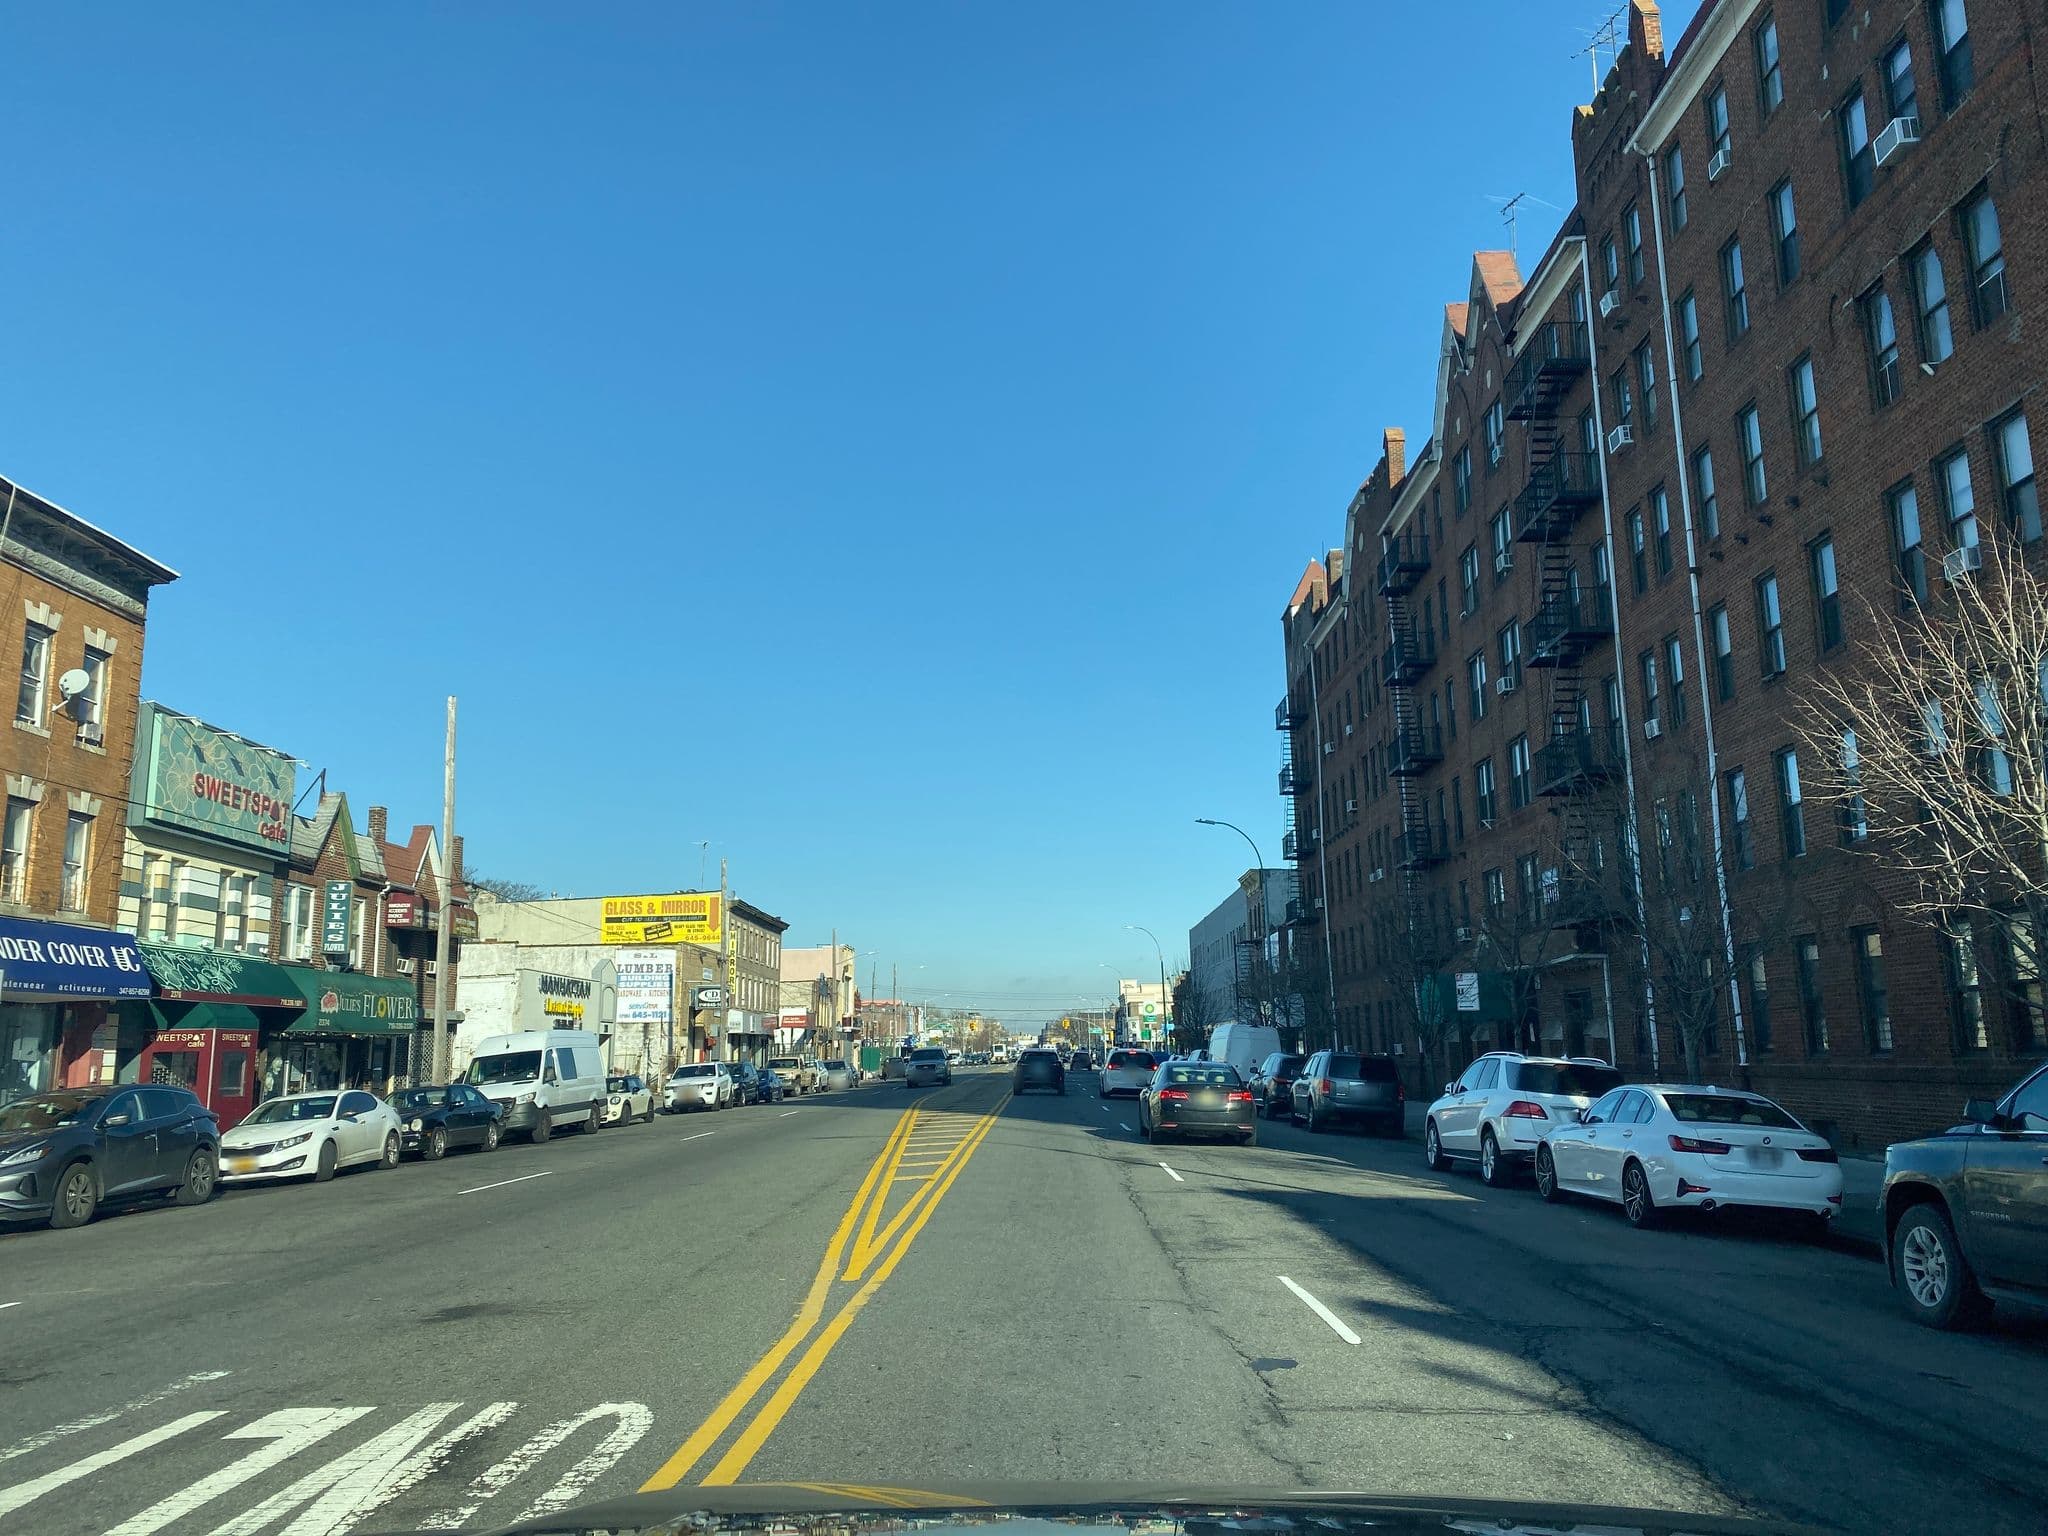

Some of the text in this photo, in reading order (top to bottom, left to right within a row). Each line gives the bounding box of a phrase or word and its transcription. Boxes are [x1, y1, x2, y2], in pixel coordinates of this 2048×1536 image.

[605, 900, 706, 915] GLASS & MIRROR
[323, 943, 345, 952] FLOWER
[47, 941, 110, 969] COVER
[617, 963, 673, 974] LUMBER
[58, 983, 107, 993] activewear
[363, 994, 413, 1019] FLOWER
[187, 1040, 206, 1048] cafe
